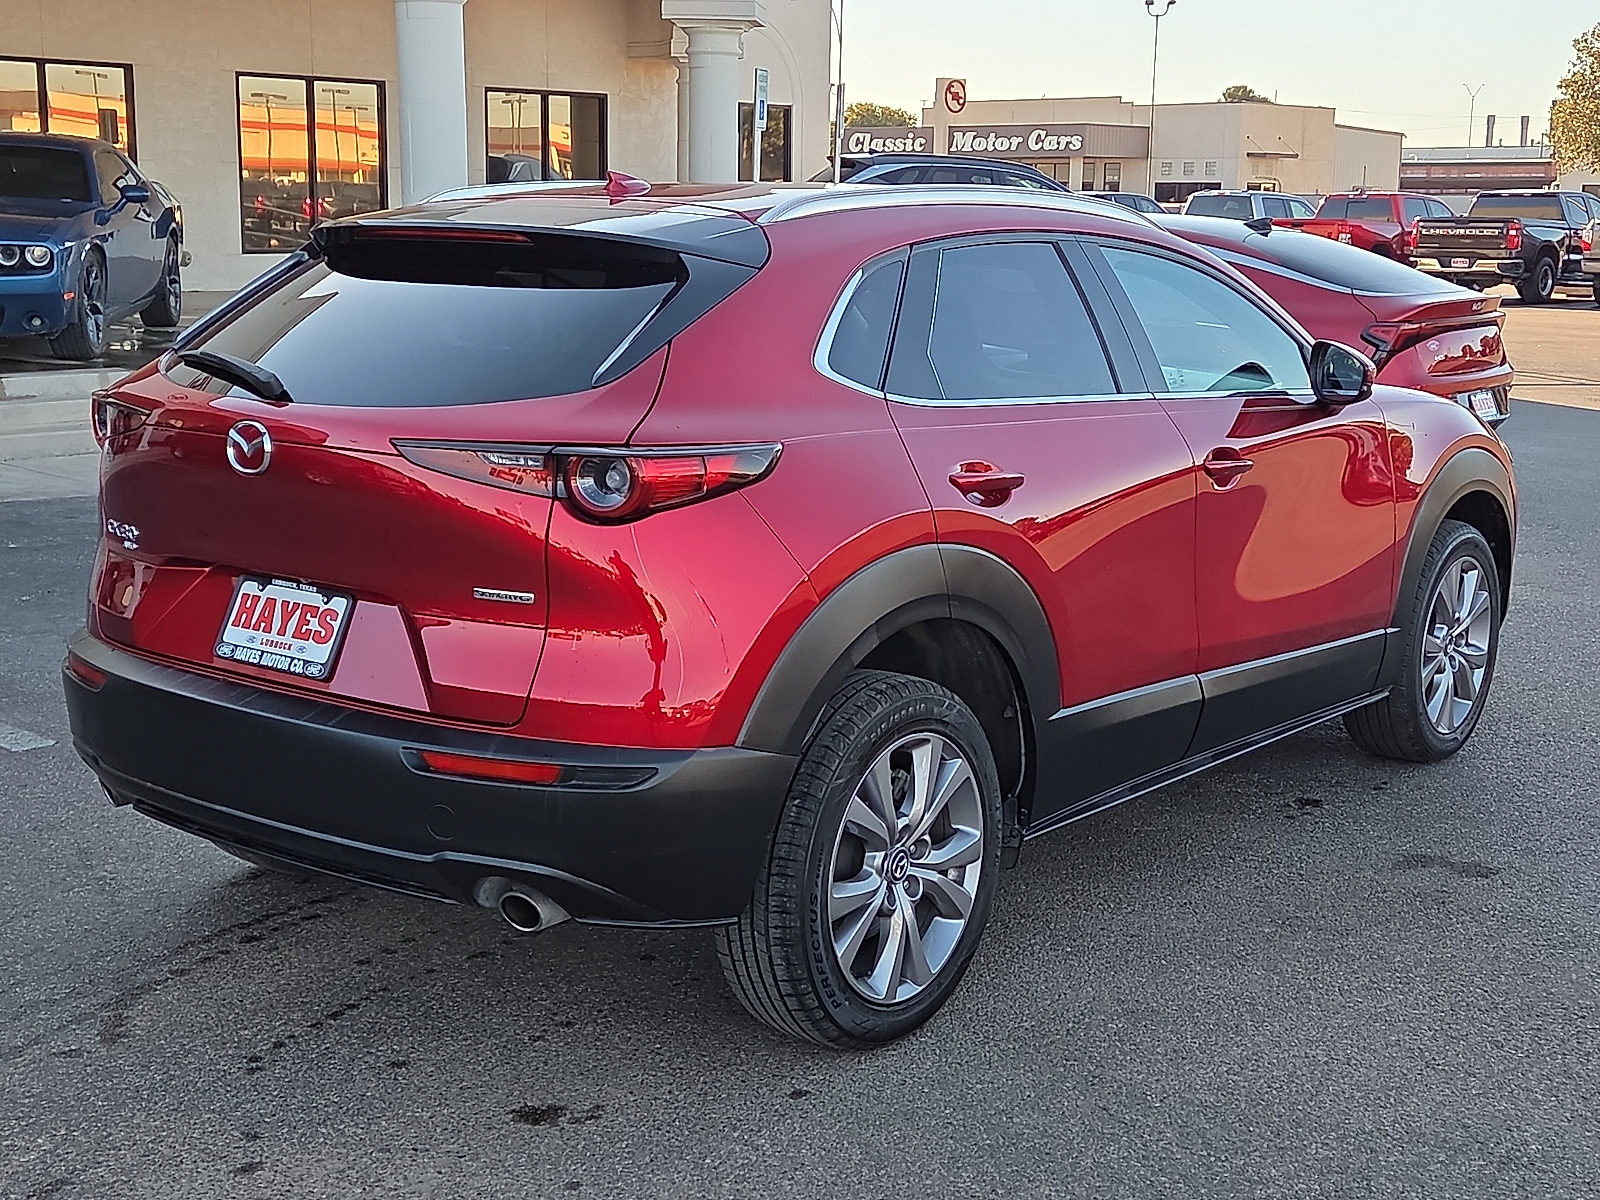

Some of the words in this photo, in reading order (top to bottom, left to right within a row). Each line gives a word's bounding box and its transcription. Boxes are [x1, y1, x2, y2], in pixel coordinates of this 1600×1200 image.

[848, 131, 927, 153] Classic
[949, 131, 1023, 152] Motor
[1027, 129, 1083, 151] Cars
[1421, 228, 1501, 236] CHEVROLET
[230, 593, 340, 645] HAYES
[260, 637, 293, 651] LUBBOCK
[234, 646, 262, 663] HAYES
[260, 652, 291, 670] MOTOR
[290, 659, 304, 673] CO.
[809, 892, 843, 1010] PERFECTUS
